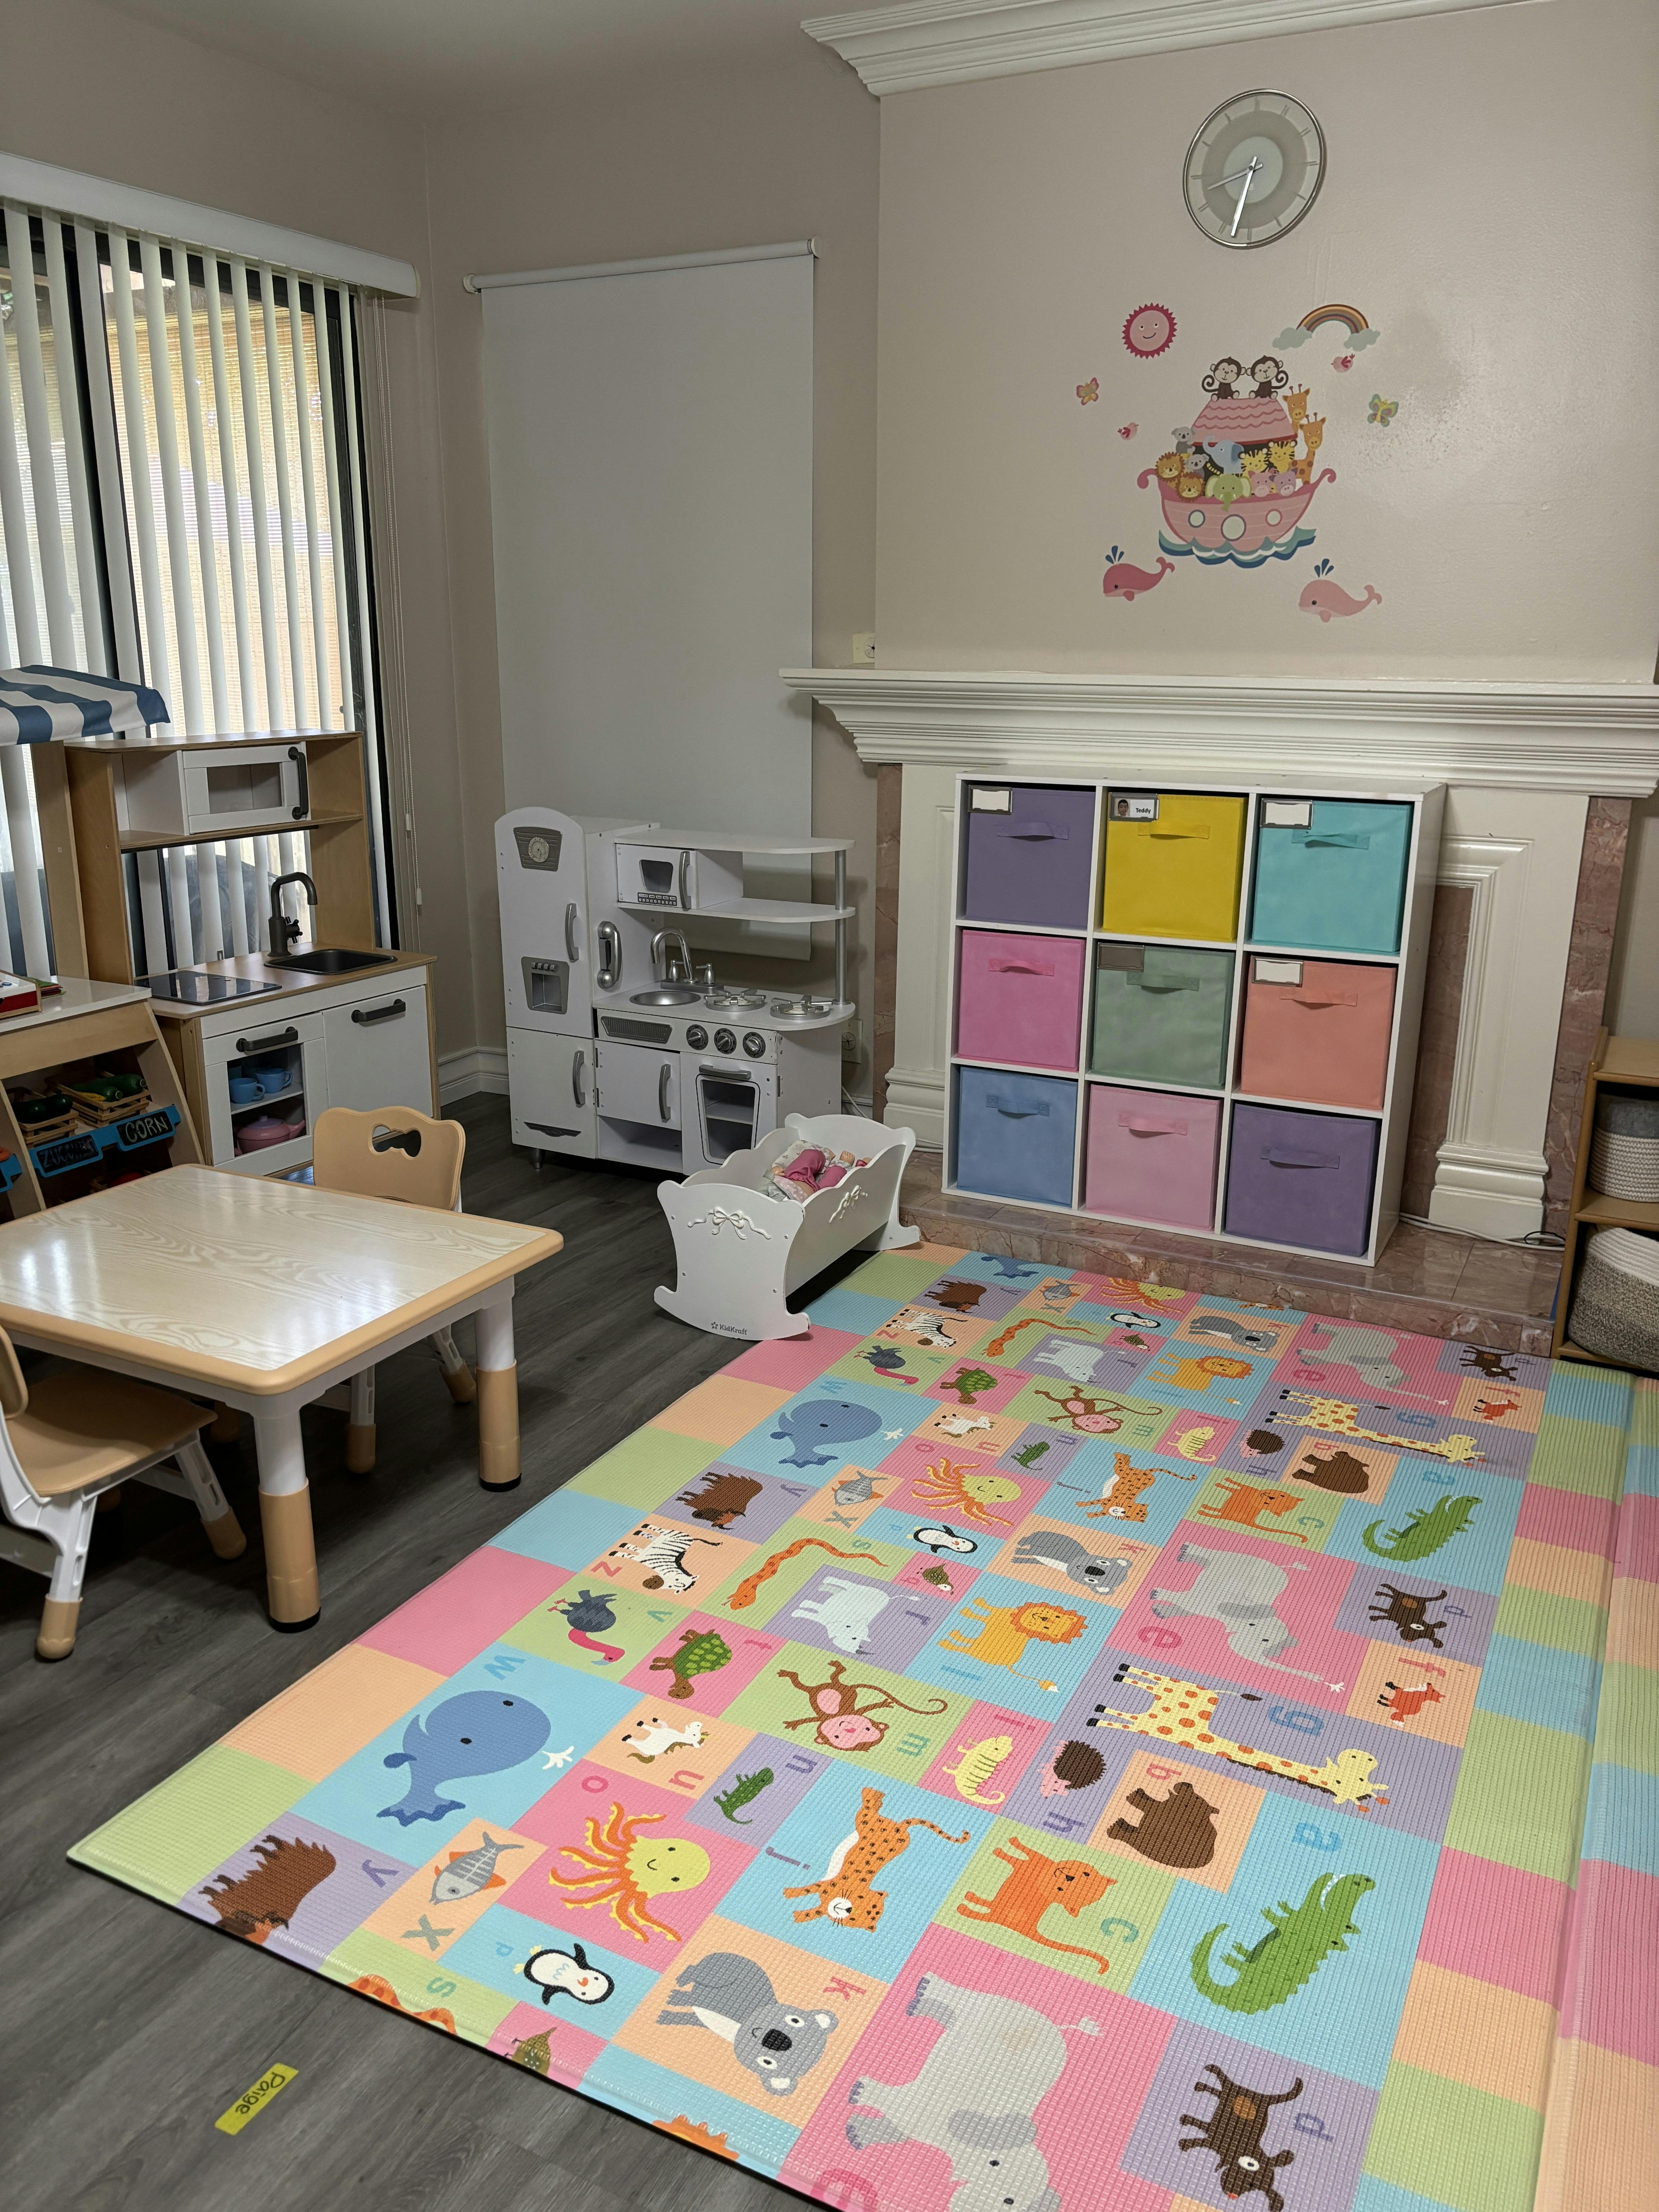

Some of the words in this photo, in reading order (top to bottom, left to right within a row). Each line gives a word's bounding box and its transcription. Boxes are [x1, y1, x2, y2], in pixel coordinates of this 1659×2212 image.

[125, 1116, 168, 1143] CORN
[719, 1324, 748, 1335] KidKraft
[235, 2072, 285, 2114] Paige
